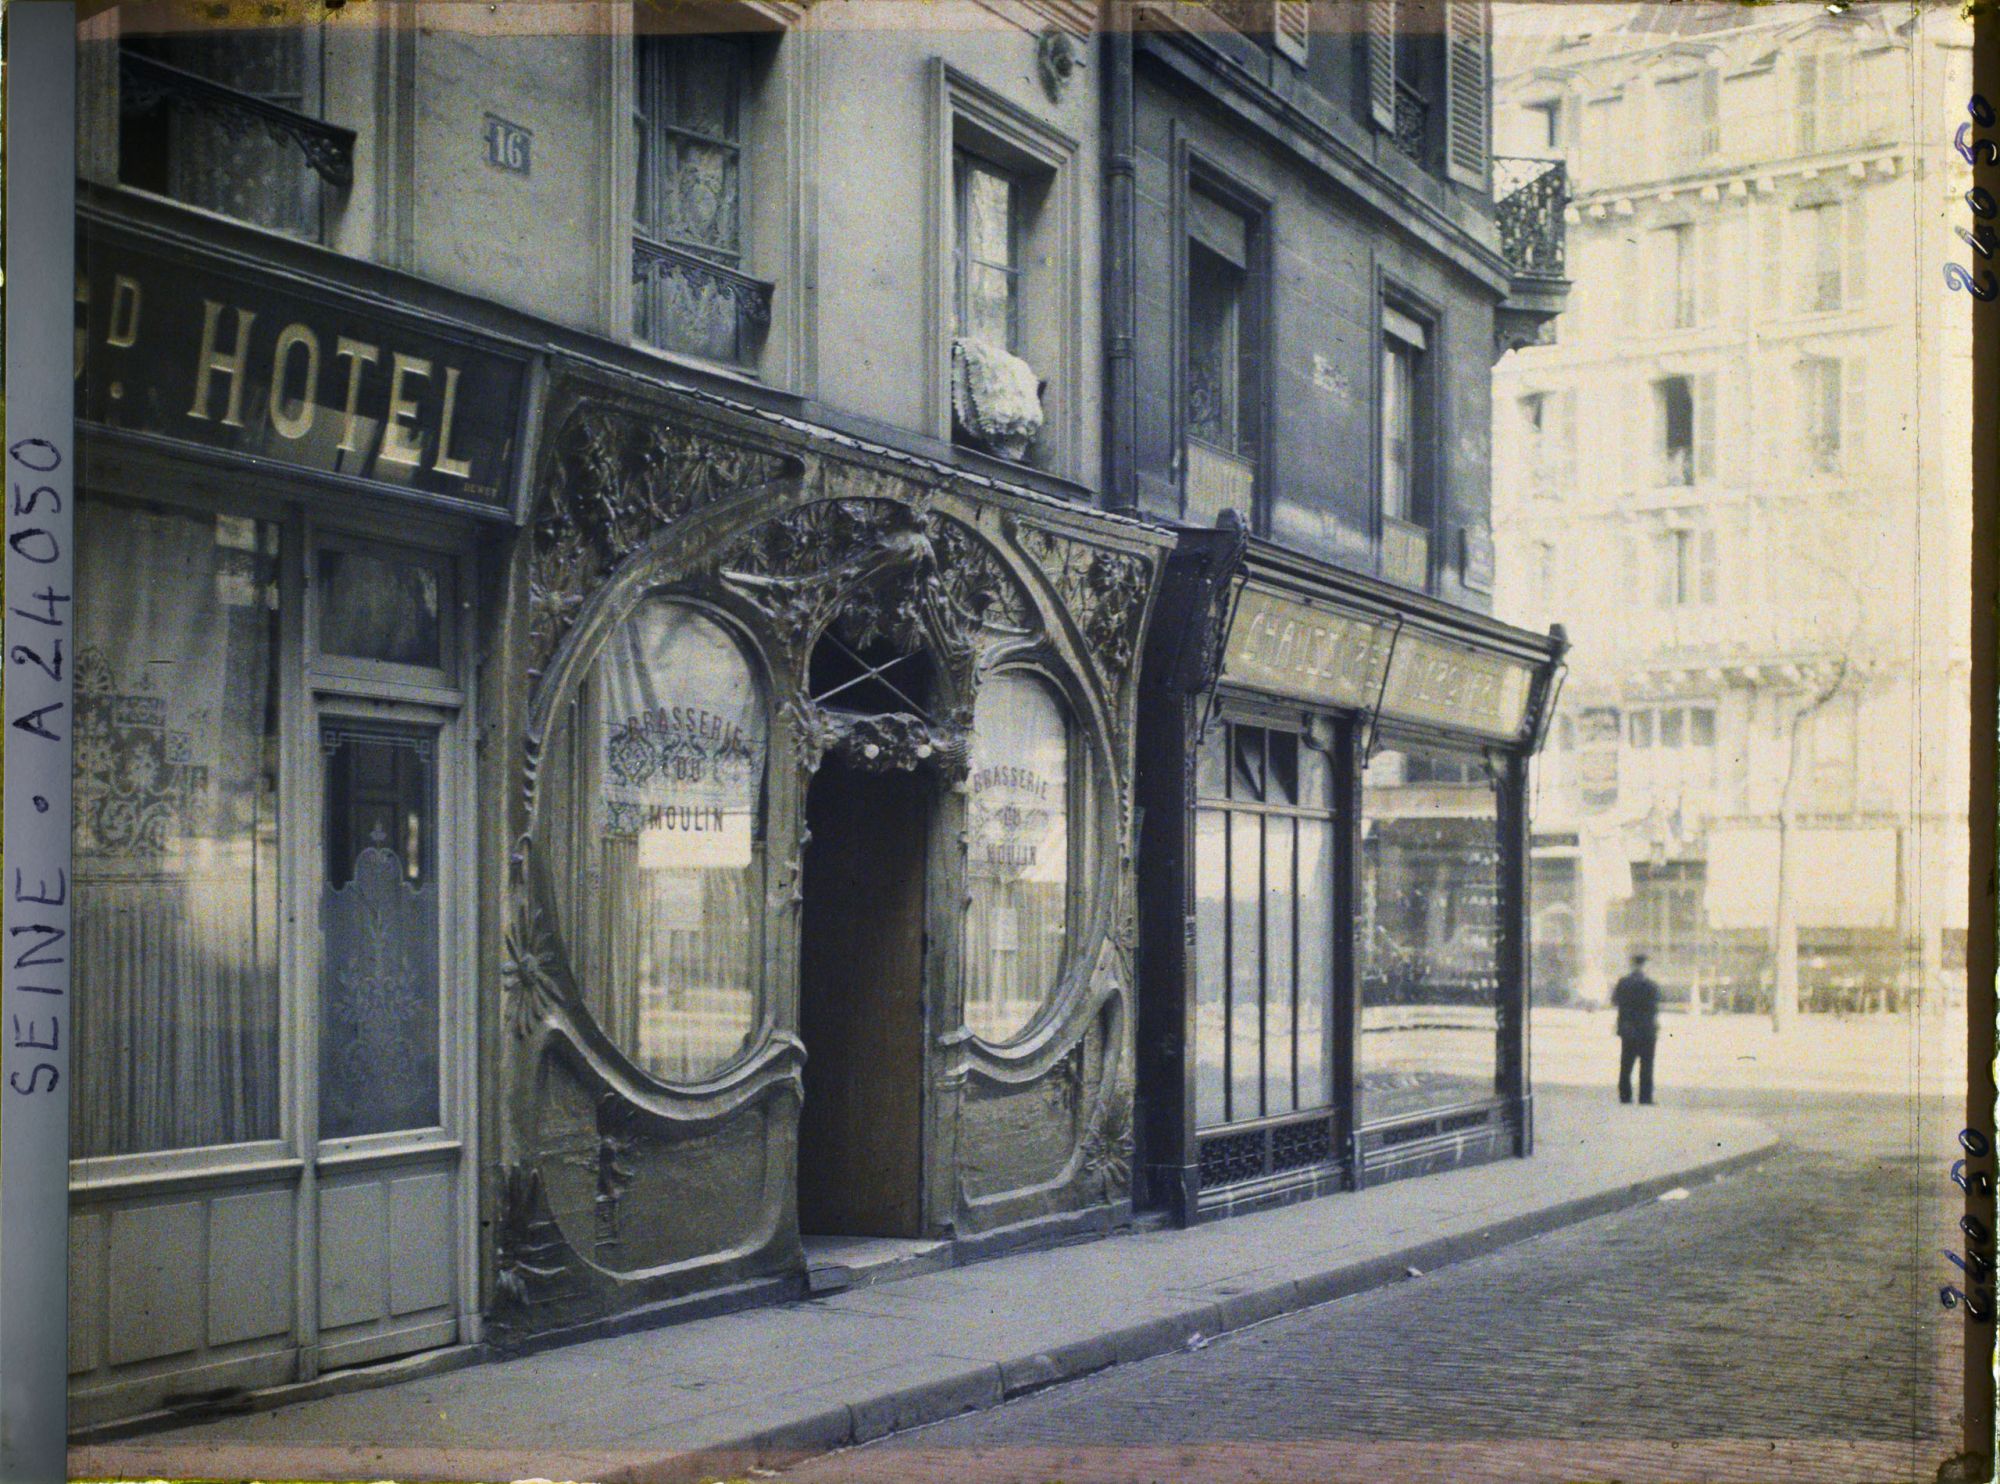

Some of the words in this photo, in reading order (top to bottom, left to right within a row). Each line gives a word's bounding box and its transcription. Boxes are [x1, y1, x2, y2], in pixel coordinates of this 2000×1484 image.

[497, 126, 522, 168] 16
[186, 299, 472, 478] HOTEL
[9, 438, 71, 741] A24050
[627, 706, 743, 757] BRASSERIE
[675, 756, 702, 782] DU
[973, 765, 1048, 801] BRASSERIE
[649, 804, 723, 832] MOULIN
[10, 867, 66, 1095] SEINE
